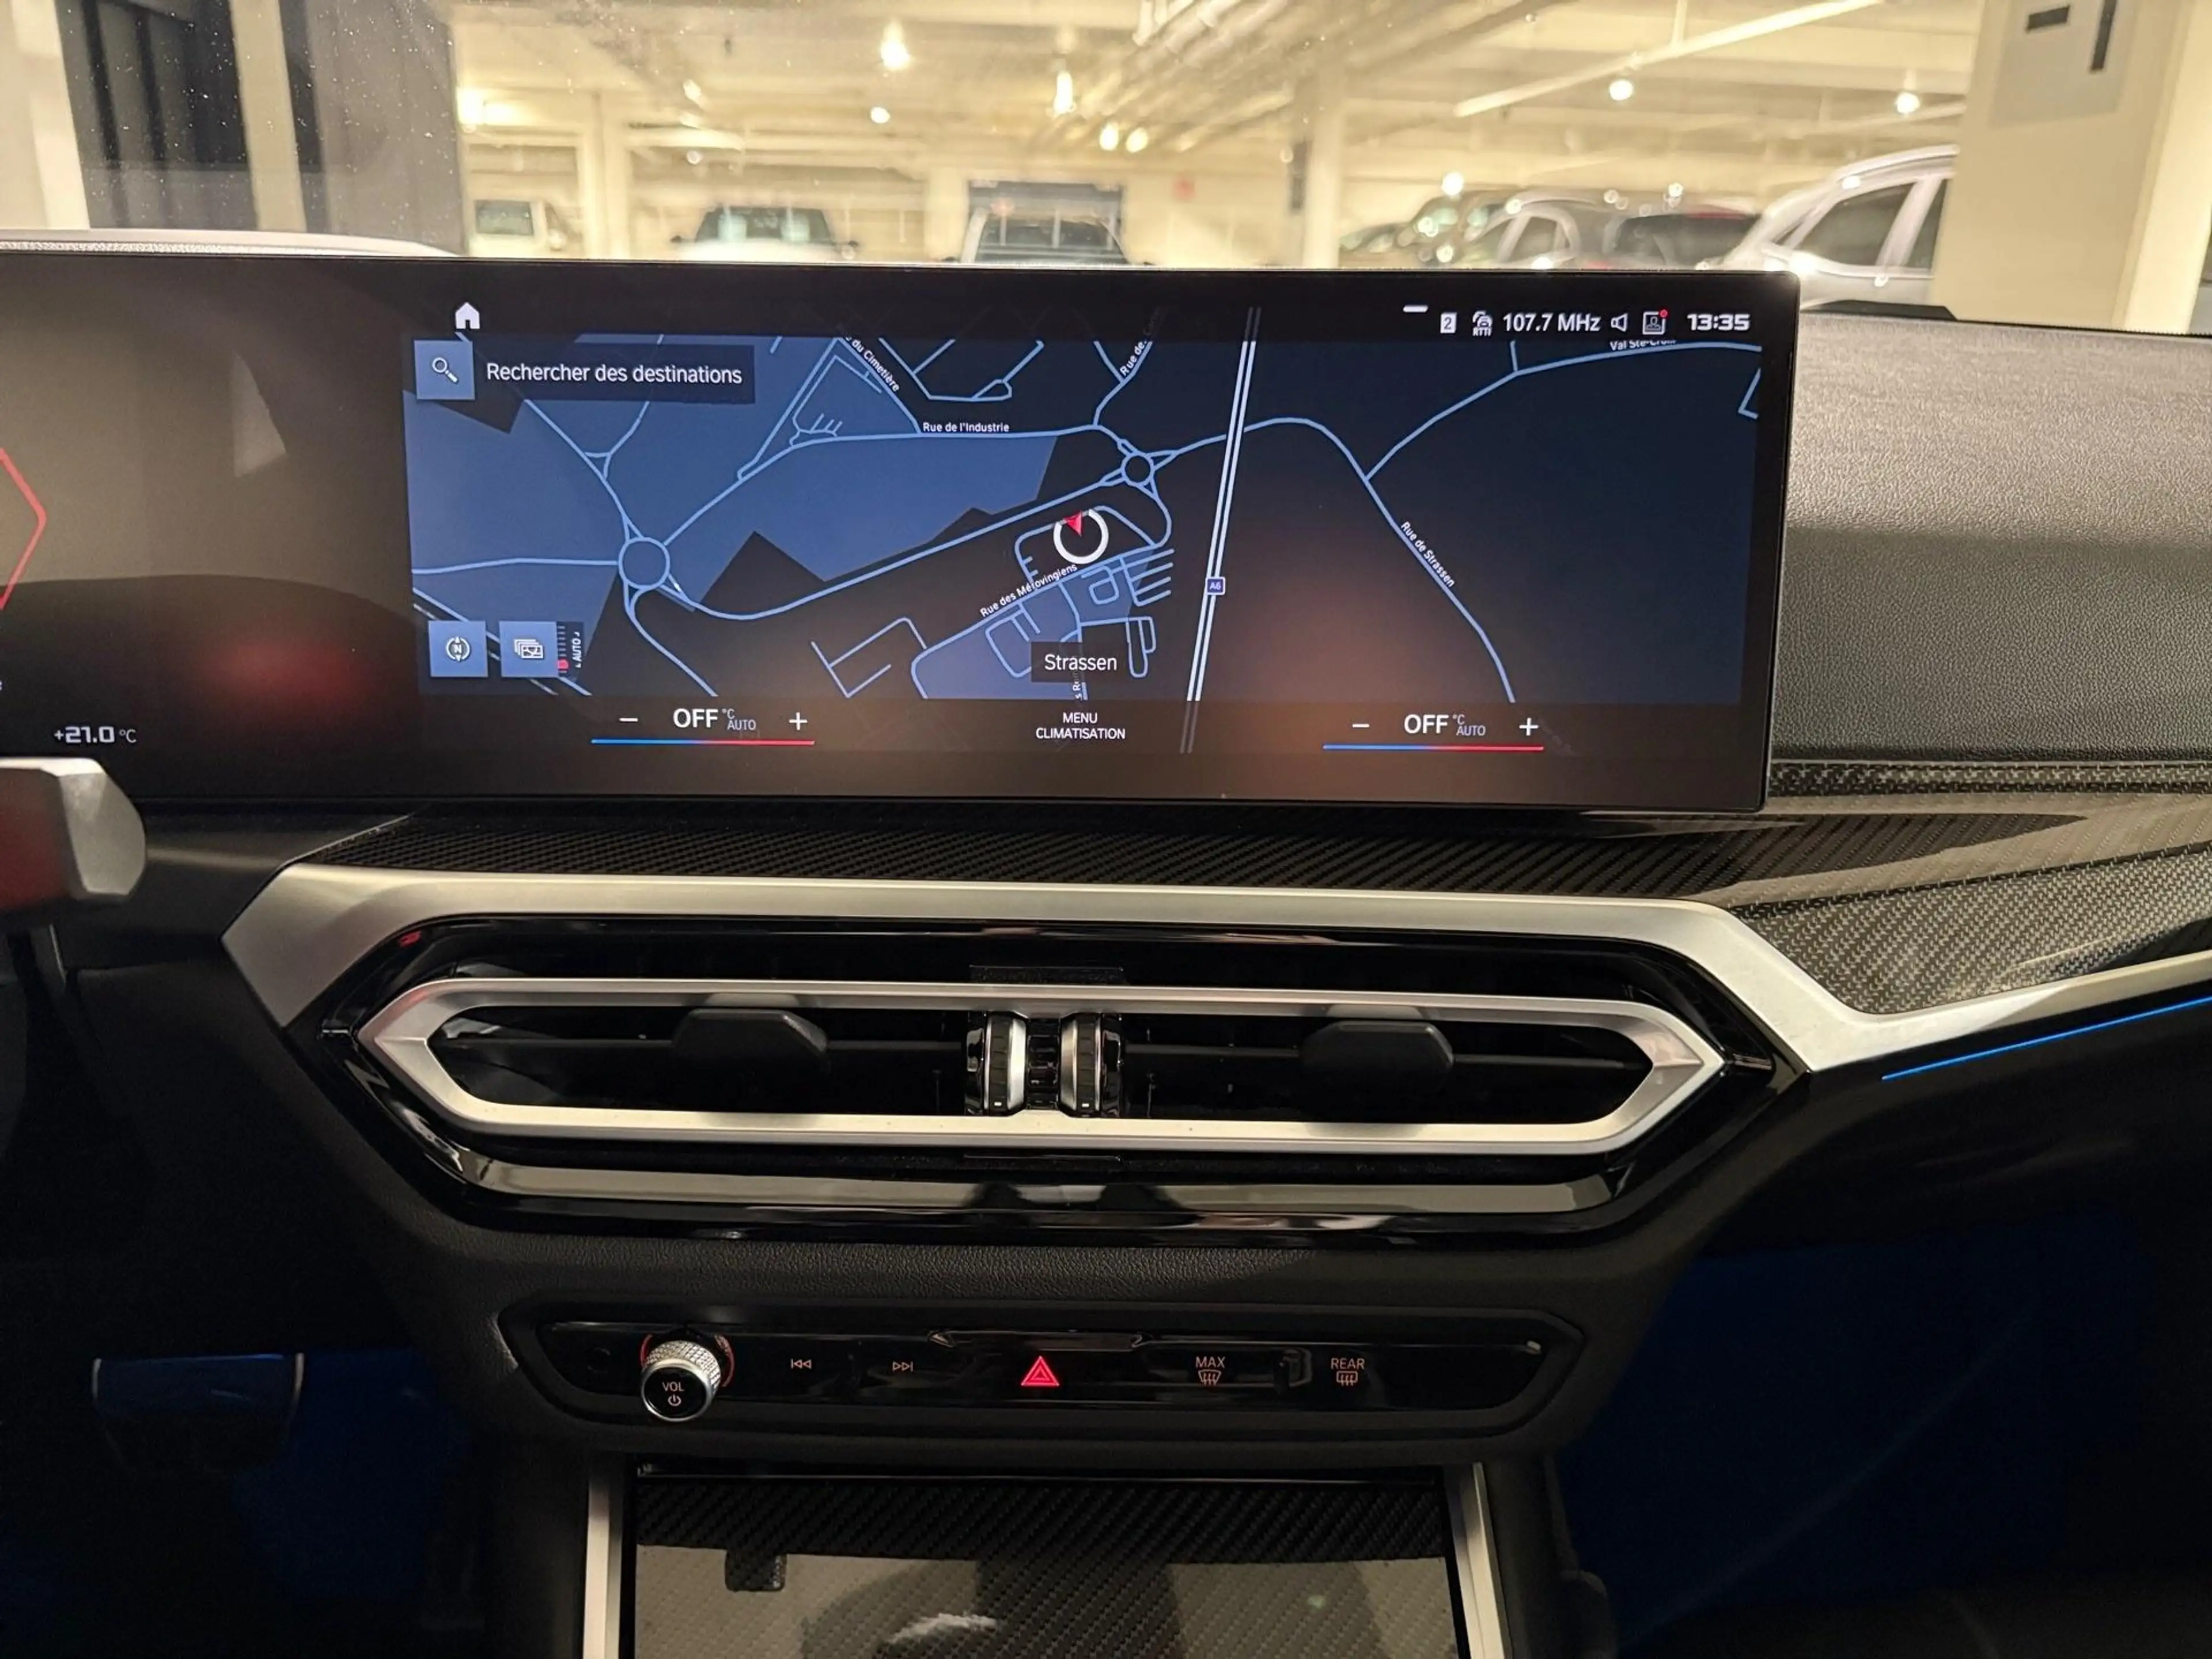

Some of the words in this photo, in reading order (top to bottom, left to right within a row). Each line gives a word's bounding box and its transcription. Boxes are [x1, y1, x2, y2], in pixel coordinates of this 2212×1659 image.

[1502, 313, 1554, 332] 107.7
[1557, 313, 1601, 332] MHz
[1687, 313, 1750, 331] 13:35
[852, 339, 865, 353] du
[1609, 339, 1627, 351] Val
[1119, 354, 1138, 376] Rue
[486, 363, 590, 381] Rechercher
[595, 364, 628, 382] des
[632, 365, 743, 384] destinations
[922, 421, 943, 432] Rue
[944, 422, 958, 432] de
[959, 422, 1010, 433] l'Industrie
[1401, 521, 1417, 541] Rue
[1414, 540, 1427, 553] de
[1423, 549, 1455, 588] Strassen
[980, 602, 999, 618] Rue
[999, 593, 1017, 606] des
[1016, 563, 1078, 597] Mérovingiens
[1209, 581, 1222, 591] A6
[571, 638, 582, 662] AUTO
[1044, 654, 1118, 671] Strassen
[672, 708, 719, 729] OFF
[726, 719, 757, 731] AUTO
[1062, 712, 1099, 724] MENU
[1403, 714, 1449, 734] OFF
[53, 725, 116, 744] +21.0
[1035, 727, 1126, 740] CLIMATISATION
[1456, 725, 1487, 737] AUTO
[1195, 1356, 1226, 1369] MAX
[1330, 1357, 1366, 1370] REAR
[661, 1381, 685, 1392] VOL
